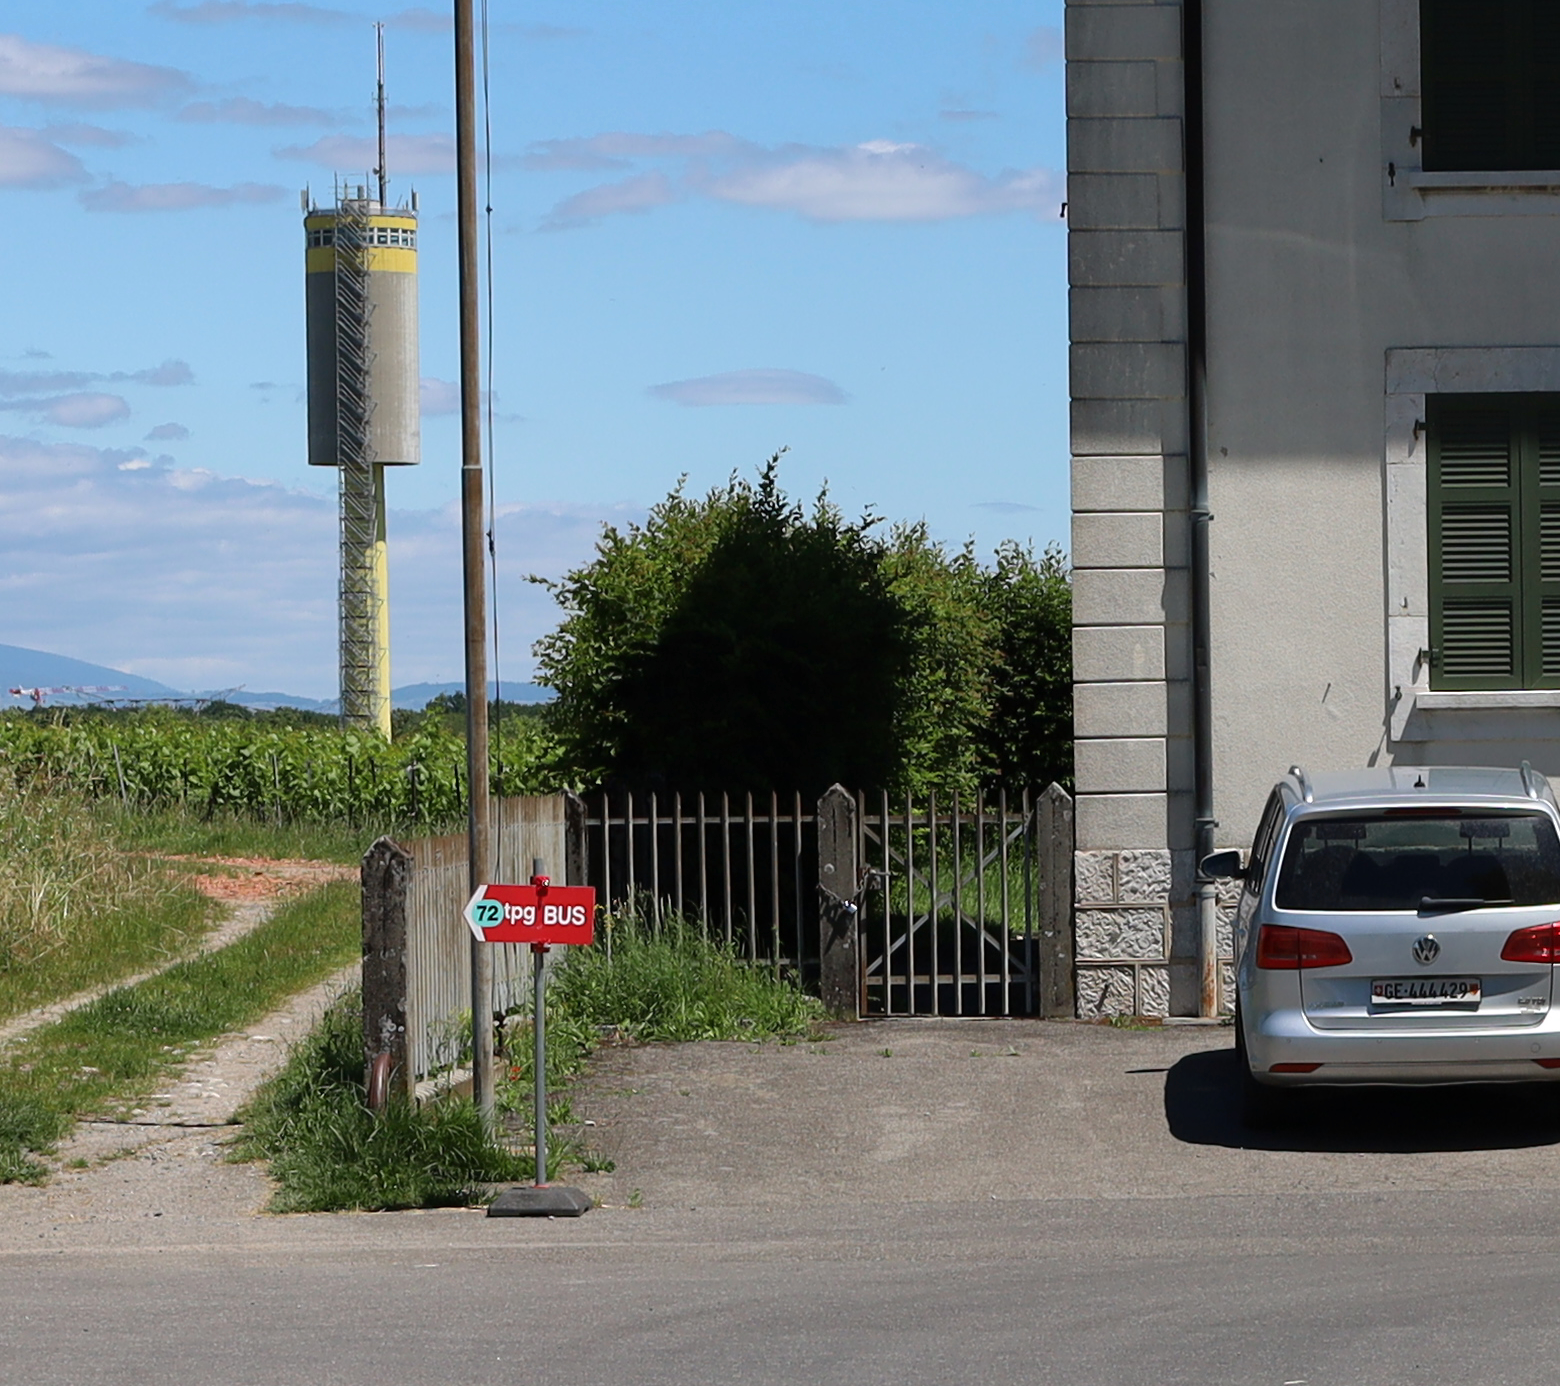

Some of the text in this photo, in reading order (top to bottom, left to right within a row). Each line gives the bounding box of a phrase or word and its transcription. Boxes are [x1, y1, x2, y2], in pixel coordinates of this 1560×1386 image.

[476, 902, 586, 926] 72 tpg BUS
